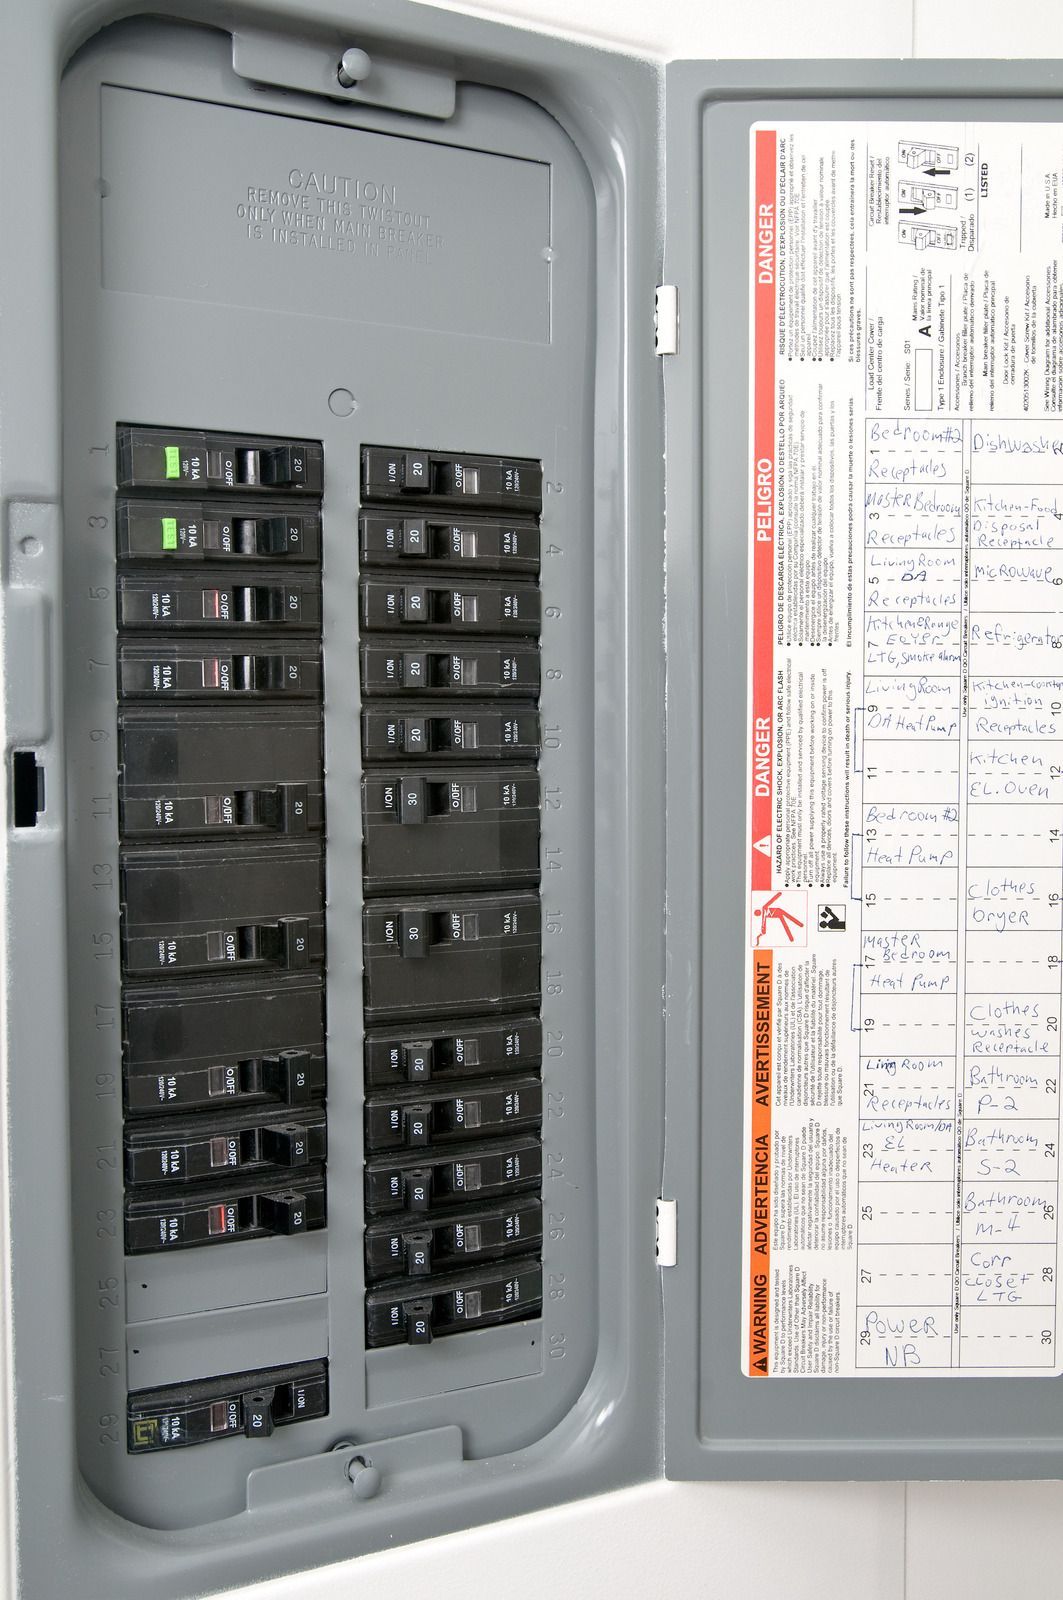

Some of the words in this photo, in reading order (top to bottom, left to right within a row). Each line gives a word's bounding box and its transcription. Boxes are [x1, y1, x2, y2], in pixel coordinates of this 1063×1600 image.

[964, 153, 975, 166] (2)
[288, 168, 396, 205] CAUTION
[981, 163, 989, 198] LISTED
[964, 188, 975, 202] (1)
[247, 186, 310, 210] REMOVE
[318, 198, 351, 216] THIS
[360, 205, 431, 229] TWISTOUT
[236, 204, 276, 223] ONLY
[282, 210, 326, 231] WHEN
[334, 218, 371, 238] MAIN
[379, 225, 444, 249] BREAKER
[247, 224, 263, 240] IS
[273, 227, 356, 254] INSTALLED
[366, 243, 379, 257] IN
[758, 203, 773, 284] DANGER
[919, 325, 931, 338] A
[294, 458, 303, 472] 20
[413, 462, 423, 476] 20
[869, 459, 947, 482] Receptacles
[506, 470, 513, 480] kA
[506, 482, 513, 490] 10
[757, 458, 772, 541] PELIGRO
[914, 490, 961, 514] Bedroom
[290, 528, 298, 541] 20
[410, 530, 419, 543] 20
[867, 524, 956, 547] Receptacles
[977, 534, 1054, 548] Receptacle
[871, 555, 915, 571] Living
[918, 553, 955, 567] Room
[89, 586, 110, 600] 5
[868, 590, 956, 608] Receptacles
[289, 596, 298, 609] 20
[411, 596, 420, 609] 20
[289, 665, 298, 679] 20
[411, 662, 420, 675] 20
[546, 669, 562, 680] 8
[866, 680, 916, 701] Living
[917, 676, 951, 694] Room
[1051, 702, 1062, 716] 10
[777, 712, 783, 723] OR
[976, 717, 1056, 735] Receptacles
[412, 728, 420, 741] 20
[756, 717, 770, 797] DANGER
[970, 748, 1043, 766] Kitchen
[1050, 765, 1061, 780] 12
[1005, 781, 1049, 798] Oven
[408, 792, 417, 805] 30
[295, 801, 303, 815] 20
[866, 806, 938, 823] Bedroom
[776, 833, 783, 843] OF
[867, 828, 877, 843] 13
[1050, 829, 1059, 843] 14
[867, 847, 903, 864] Heat
[909, 845, 953, 865] Pump
[866, 893, 876, 907] 15
[1049, 893, 1059, 907] 16
[409, 927, 419, 940] 30
[296, 937, 304, 951] 20
[865, 955, 875, 969] 17
[883, 949, 951, 961] Bedroom
[1048, 955, 1058, 969] 18
[870, 975, 903, 989] Heat
[911, 974, 950, 991] Pump
[970, 1001, 1039, 1021] Clothes
[865, 1019, 875, 1032] 19
[1047, 1017, 1057, 1031] 20
[756, 962, 769, 1106] AVERTISSEMENT
[972, 1040, 1049, 1053] Receptacle
[414, 1058, 424, 1071] 20
[901, 1060, 943, 1071] Room
[296, 1073, 304, 1086] 20
[970, 1065, 1038, 1086] Bathroom
[864, 1082, 874, 1097] 21
[1046, 1079, 1056, 1094] 22
[867, 1095, 951, 1112] Receptacles
[413, 1122, 424, 1135] 20
[965, 1128, 1039, 1147] Bathroom
[296, 1141, 304, 1154] 20
[863, 1144, 873, 1158] 23
[1045, 1142, 1055, 1158] 24
[414, 1187, 424, 1200] 20
[754, 1134, 769, 1256] ADVERTENCIA
[964, 1192, 1048, 1211] Bathroom
[293, 1212, 302, 1224] 20
[862, 1205, 872, 1221] 25
[1044, 1205, 1054, 1220] 26
[414, 1251, 425, 1264] 20
[861, 1269, 872, 1284] 27
[1043, 1267, 1053, 1282] 28
[754, 1274, 767, 1355] WARNING
[414, 1321, 425, 1334] 20
[860, 1330, 871, 1346] 29
[1041, 1329, 1052, 1345] 30
[253, 1414, 262, 1427] 20
